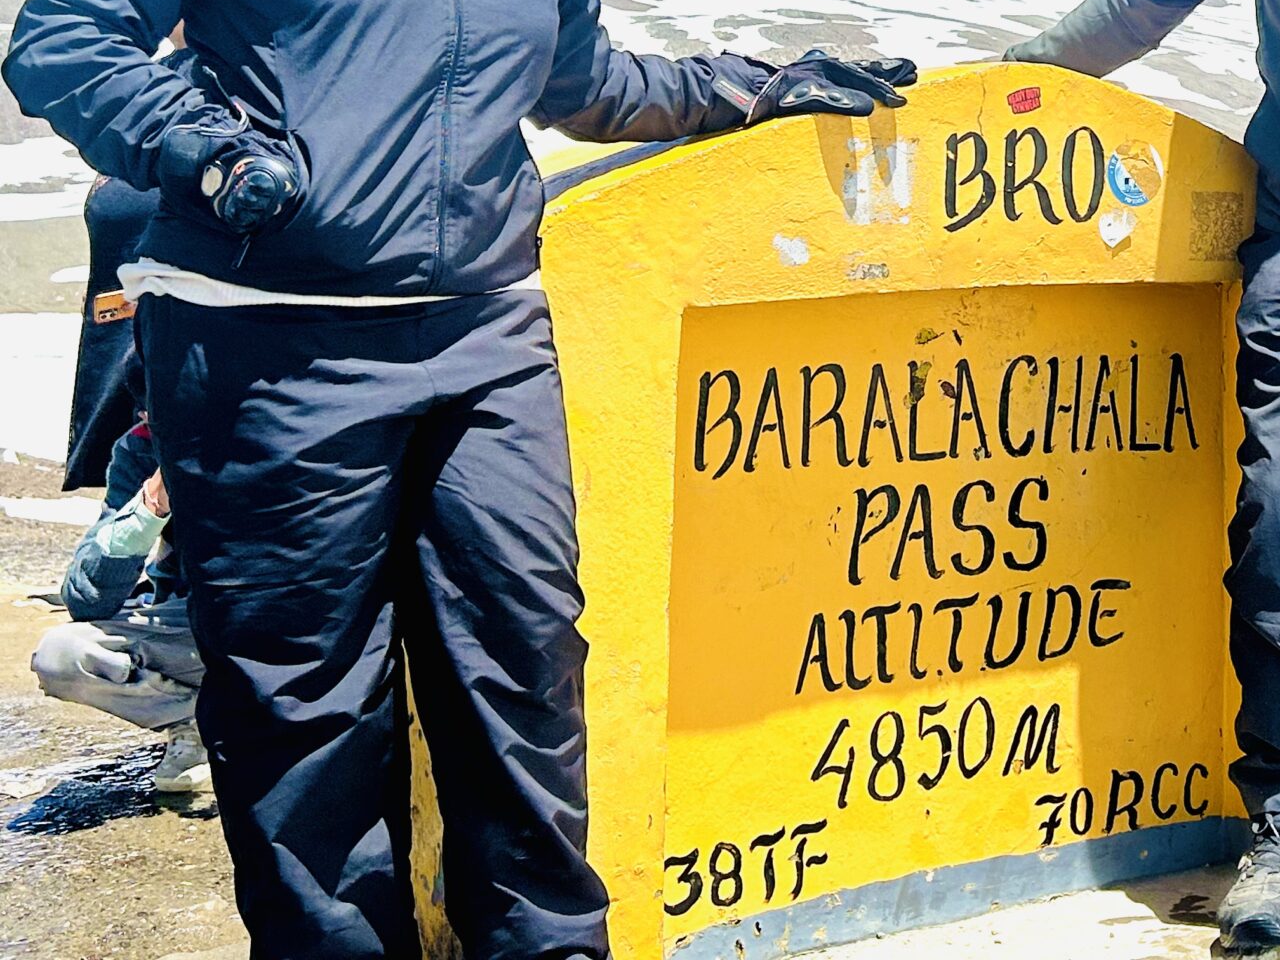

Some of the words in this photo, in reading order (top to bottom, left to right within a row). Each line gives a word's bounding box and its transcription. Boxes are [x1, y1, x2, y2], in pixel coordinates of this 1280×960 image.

[943, 126, 1104, 232] BRO
[693, 352, 1200, 480] BARALACHALA
[847, 475, 1050, 587] PASS
[810, 696, 995, 809] 4850
[1002, 702, 1062, 777] M
